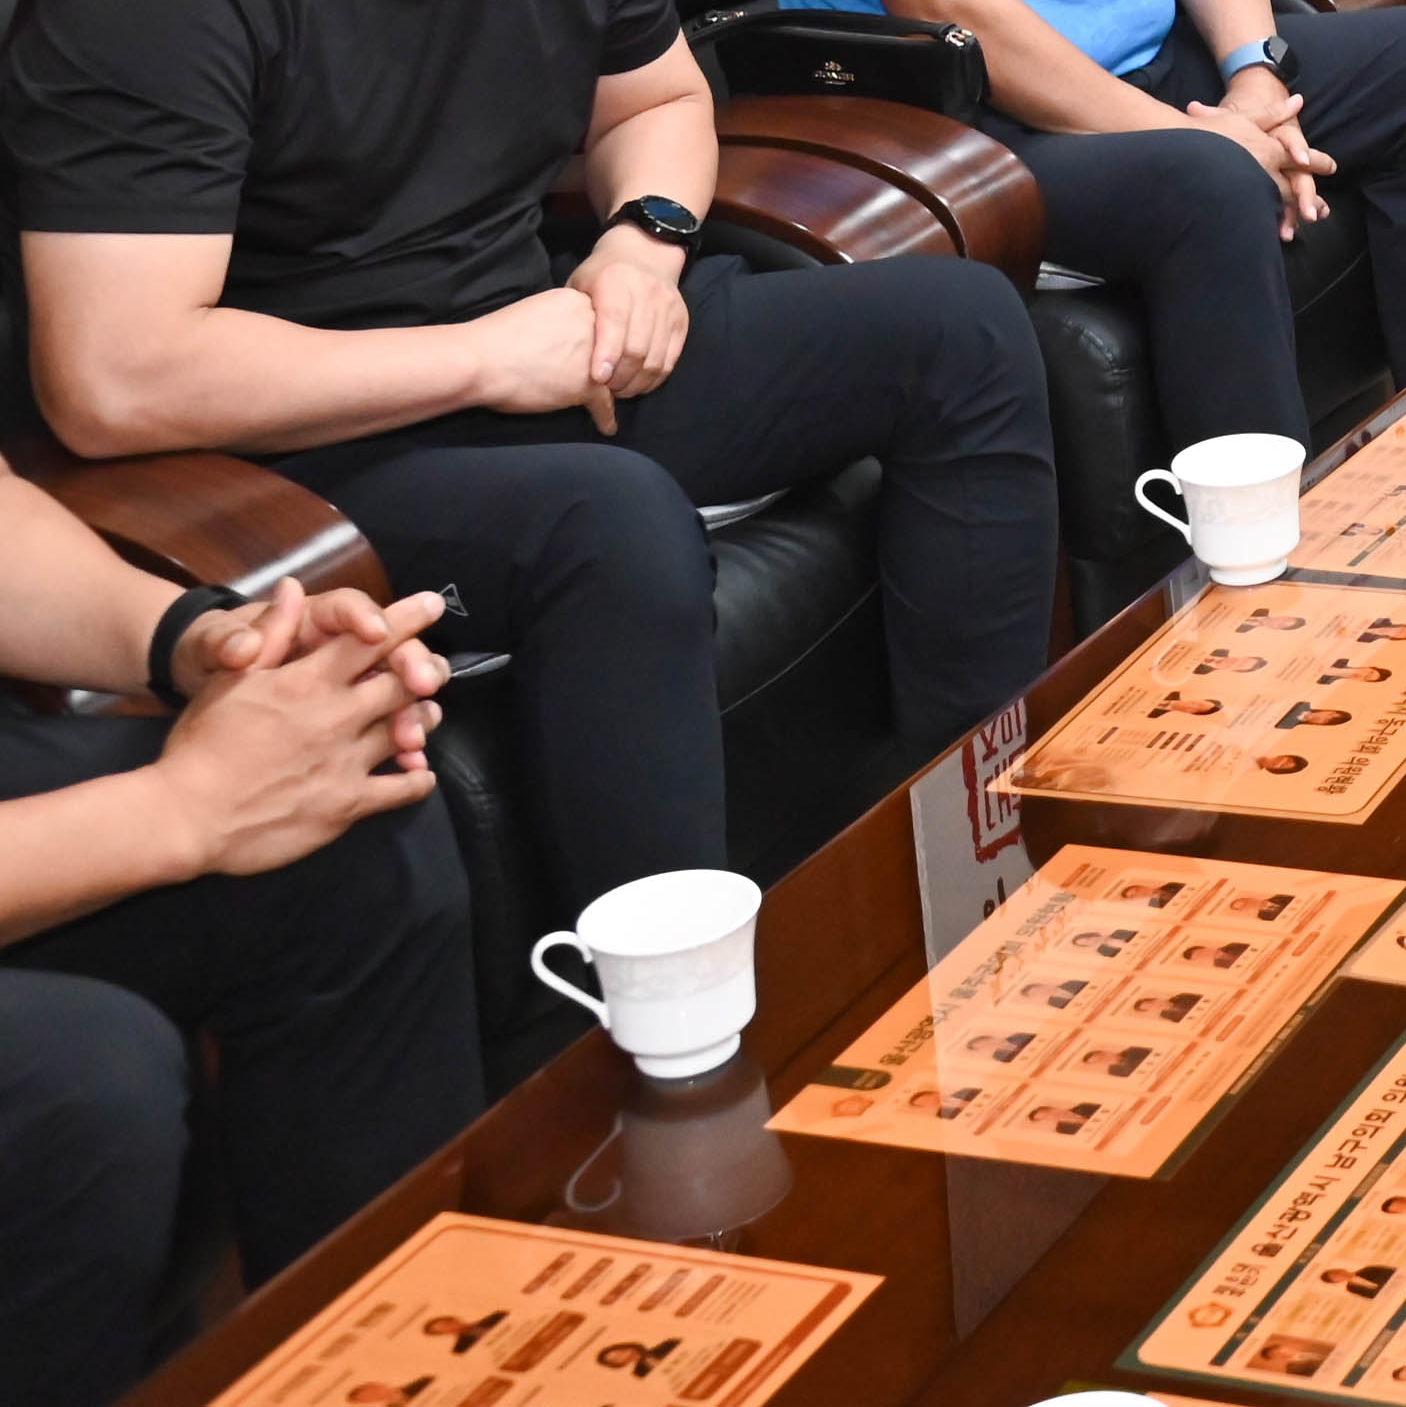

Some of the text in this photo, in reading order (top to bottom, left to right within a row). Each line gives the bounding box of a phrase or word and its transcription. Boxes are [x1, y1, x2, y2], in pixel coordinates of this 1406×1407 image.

[1352, 717, 1406, 755] 동구의회
[1314, 756, 1371, 795] 의원현황
[1251, 1175, 1341, 1258] 울산광역시
[1325, 1109, 1396, 1170] 남구의회
